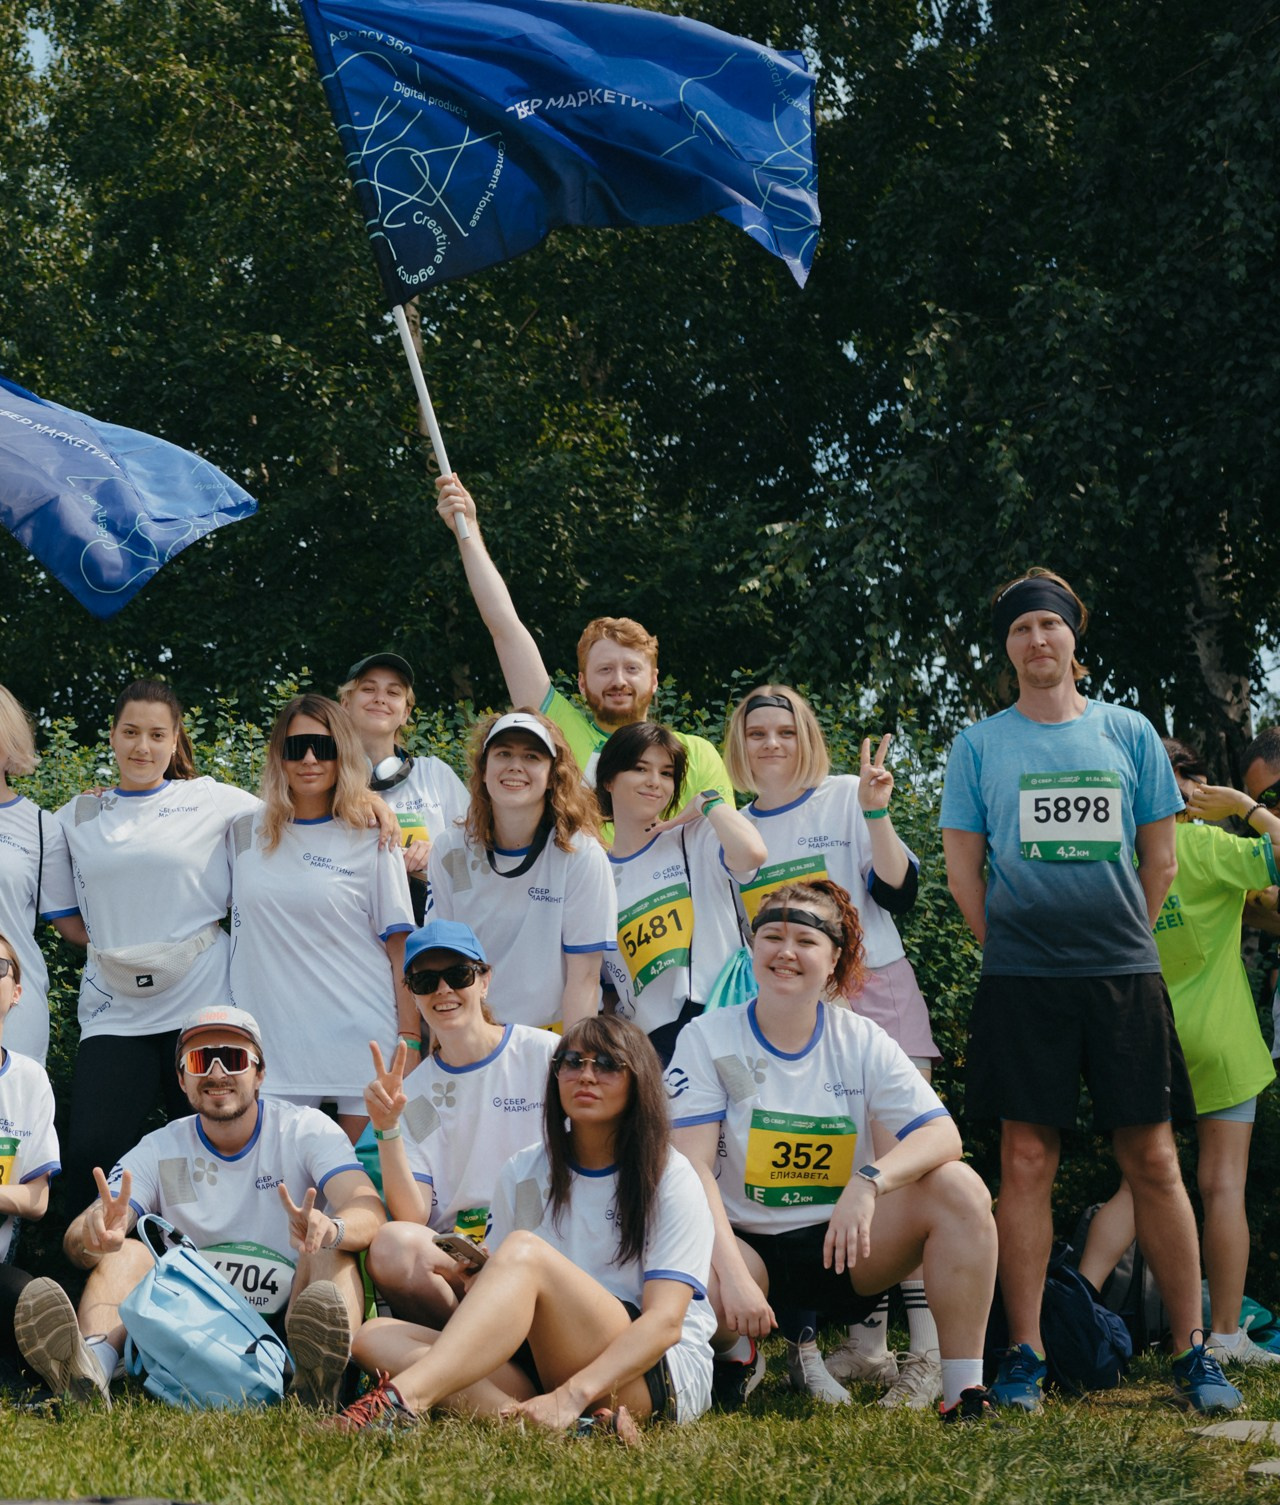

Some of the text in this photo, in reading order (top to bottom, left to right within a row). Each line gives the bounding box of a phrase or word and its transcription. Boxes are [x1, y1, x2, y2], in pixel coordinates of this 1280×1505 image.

[393, 81, 468, 118] Digital products
[505, 88, 654, 120] БЕР МАРКЕТИ
[469, 140, 506, 228] Content House
[396, 211, 451, 285] Creative agency
[1034, 796, 1110, 823] 5898
[808, 835, 829, 843] СБЕР
[1030, 843, 1042, 858] A
[310, 861, 355, 876] МАРКЕТИНГ
[313, 855, 332, 863] СБЕР
[662, 865, 680, 875] СБЕР
[622, 908, 683, 958] 5481
[1152, 912, 1184, 934] ЕЕ!
[771, 1141, 833, 1170] 352
[770, 1172, 829, 1181] ЕЛИЗАВЕТА
[214, 1261, 279, 1295] 704
